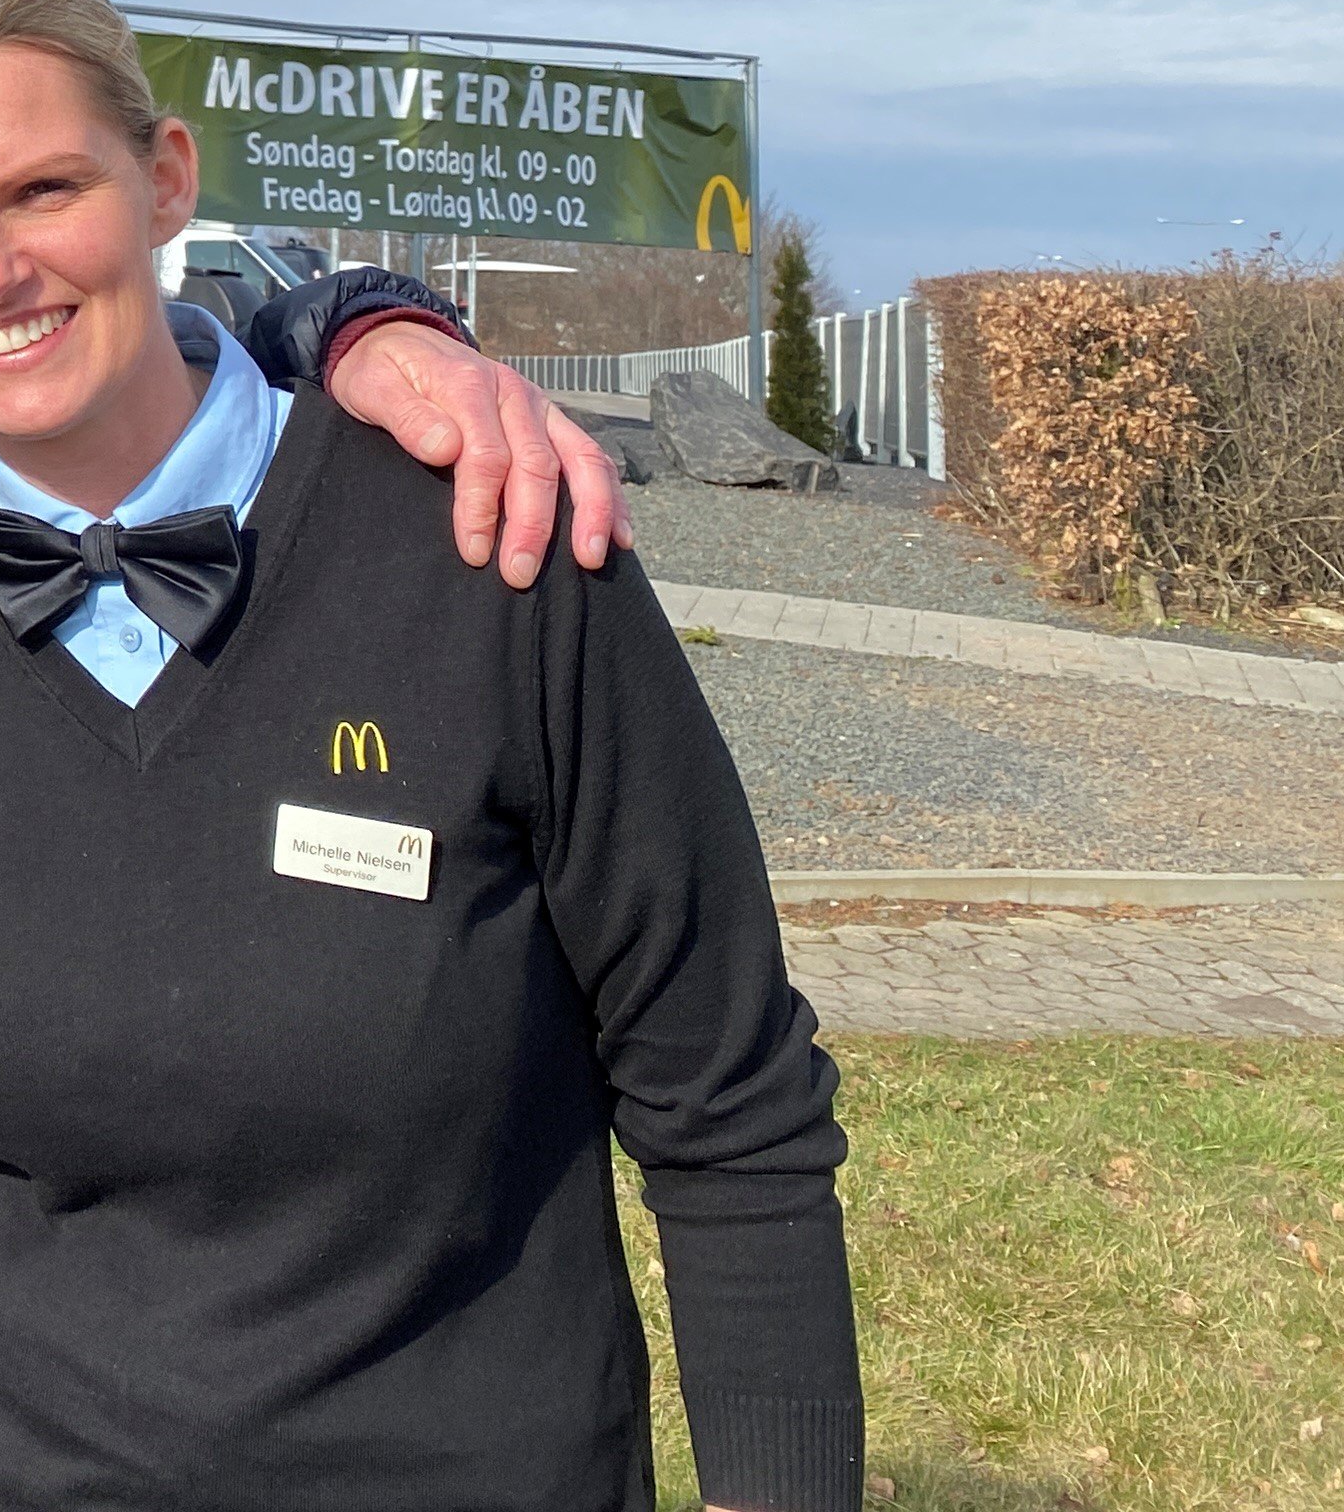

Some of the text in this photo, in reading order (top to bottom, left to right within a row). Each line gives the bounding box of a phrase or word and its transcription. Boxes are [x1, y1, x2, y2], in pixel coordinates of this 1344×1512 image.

[204, 54, 645, 140] McDRIVE ER ÅBEN
[246, 131, 356, 177] Søndag
[378, 138, 474, 186] Torsdag
[480, 143, 507, 179] kl.
[517, 151, 547, 183] 09
[565, 155, 596, 186] 00
[263, 177, 363, 222] Fredag
[387, 183, 472, 229] Lørdag
[478, 187, 505, 222] kl.
[508, 194, 538, 224] 09
[556, 197, 588, 228] 02
[292, 838, 412, 873] Michelle Nielsen
[322, 863, 377, 882] Supervisor
